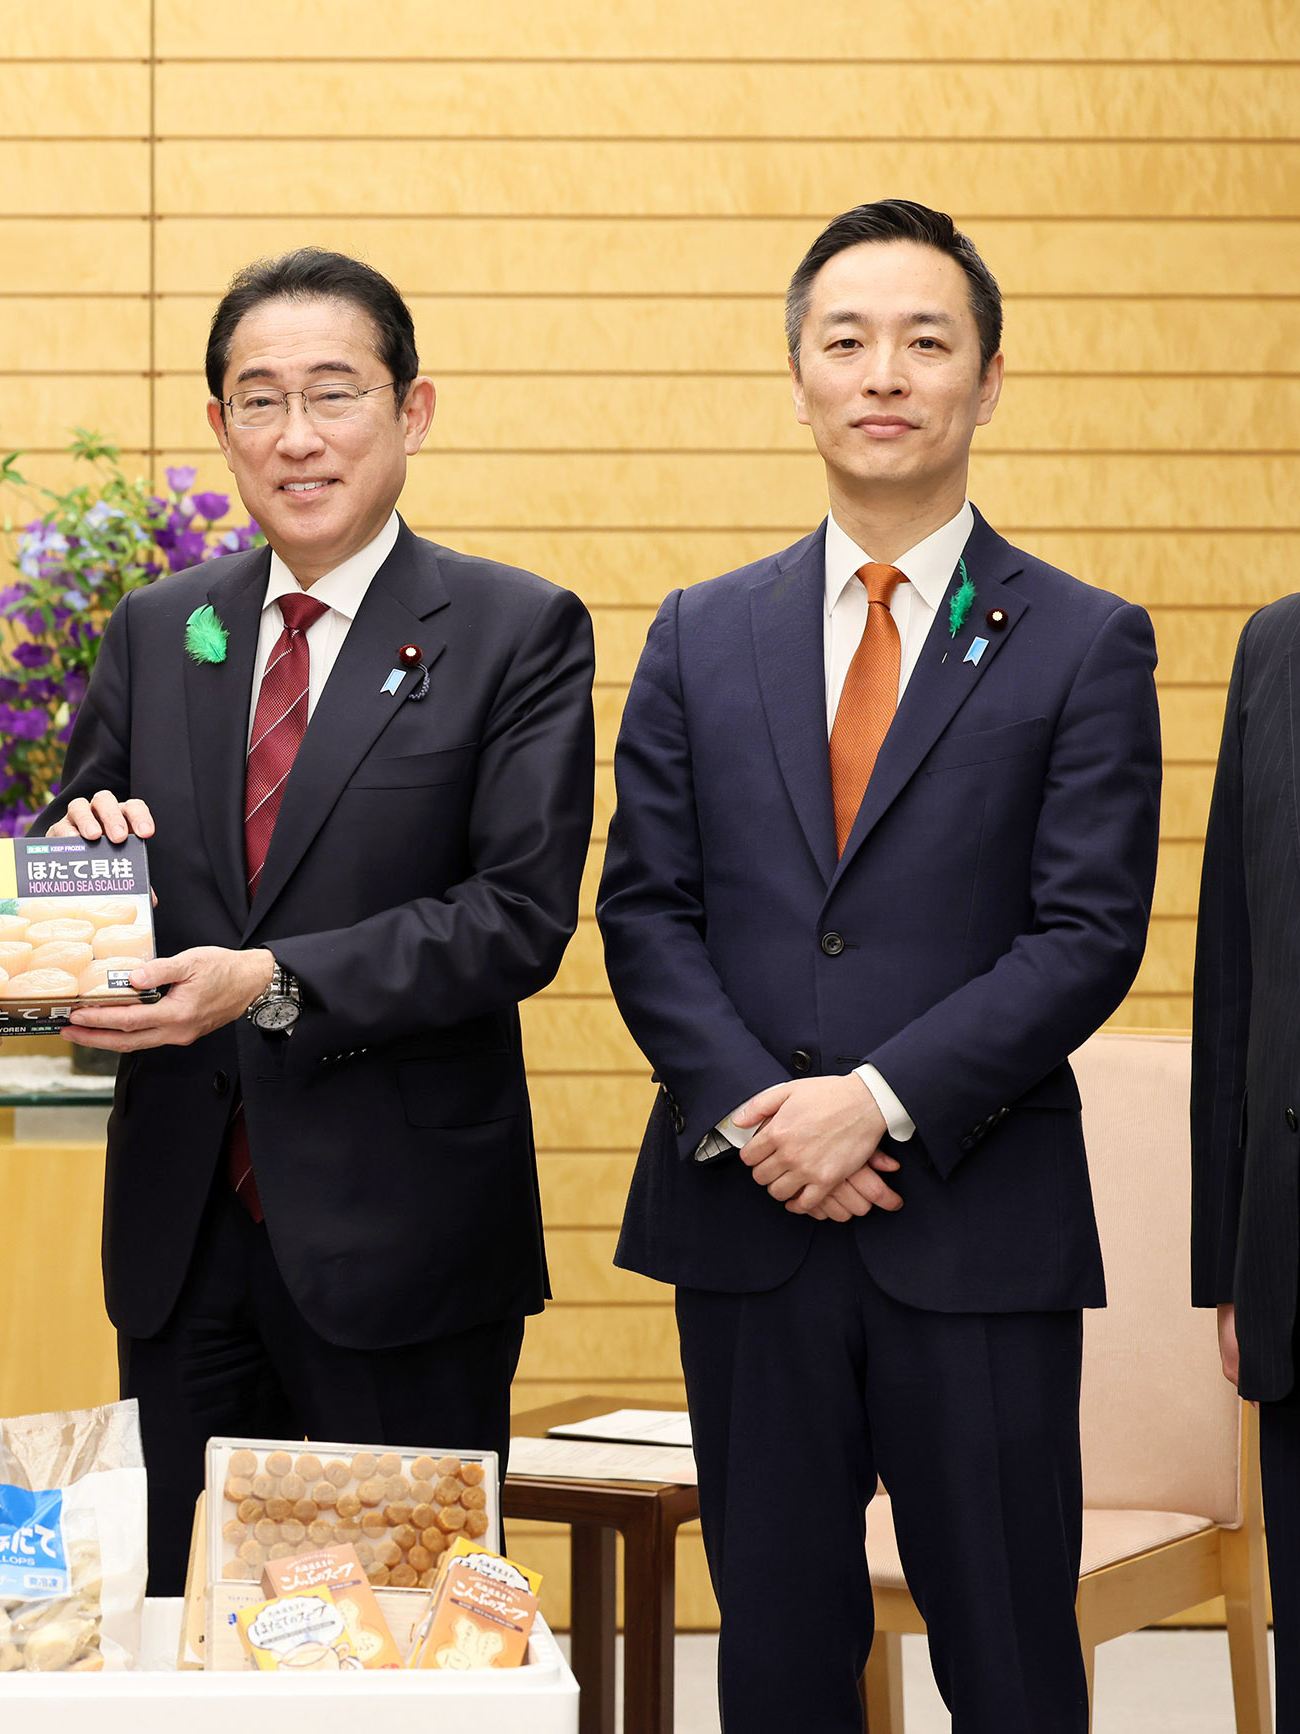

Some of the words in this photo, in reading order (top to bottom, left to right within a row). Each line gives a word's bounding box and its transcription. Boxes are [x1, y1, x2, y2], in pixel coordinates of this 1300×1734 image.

[27, 858, 134, 880] ほたて貝柱
[29, 881, 75, 893] HOKKAIDO
[76, 880, 94, 892] SEA
[95, 879, 135, 891] SCALLOP
